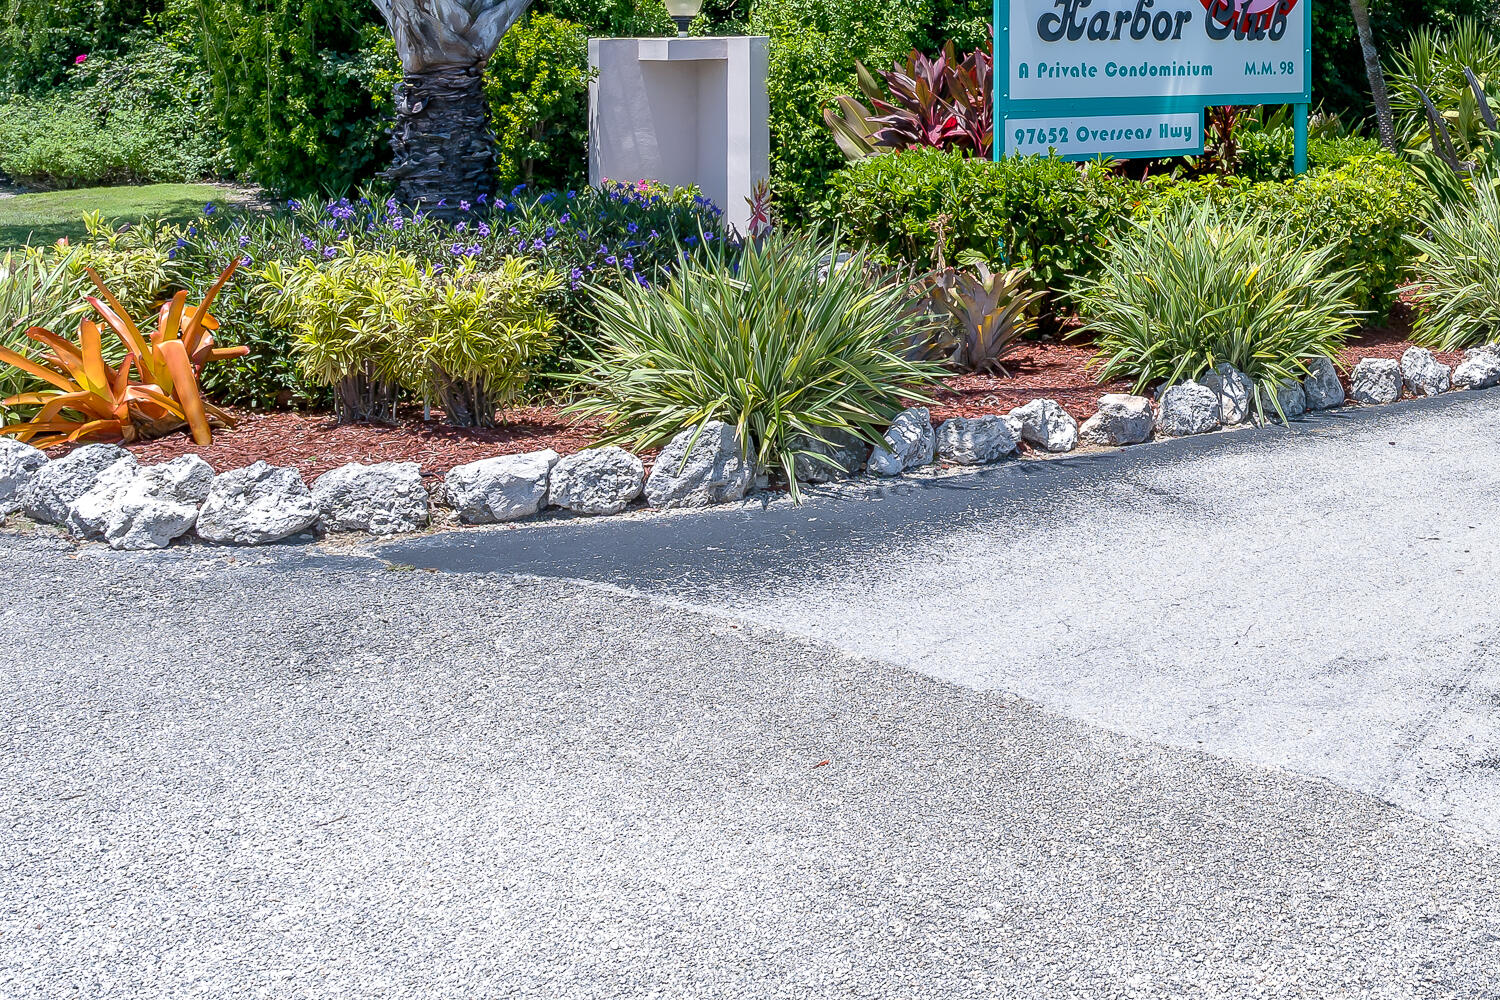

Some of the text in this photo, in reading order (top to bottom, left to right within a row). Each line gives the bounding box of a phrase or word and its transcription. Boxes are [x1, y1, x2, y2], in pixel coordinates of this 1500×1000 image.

[1018, 60, 1213, 78] A Private Condominium
[1244, 62, 1294, 76] M.M. 98
[1014, 123, 1192, 145] 97652 Overseas Hwy
